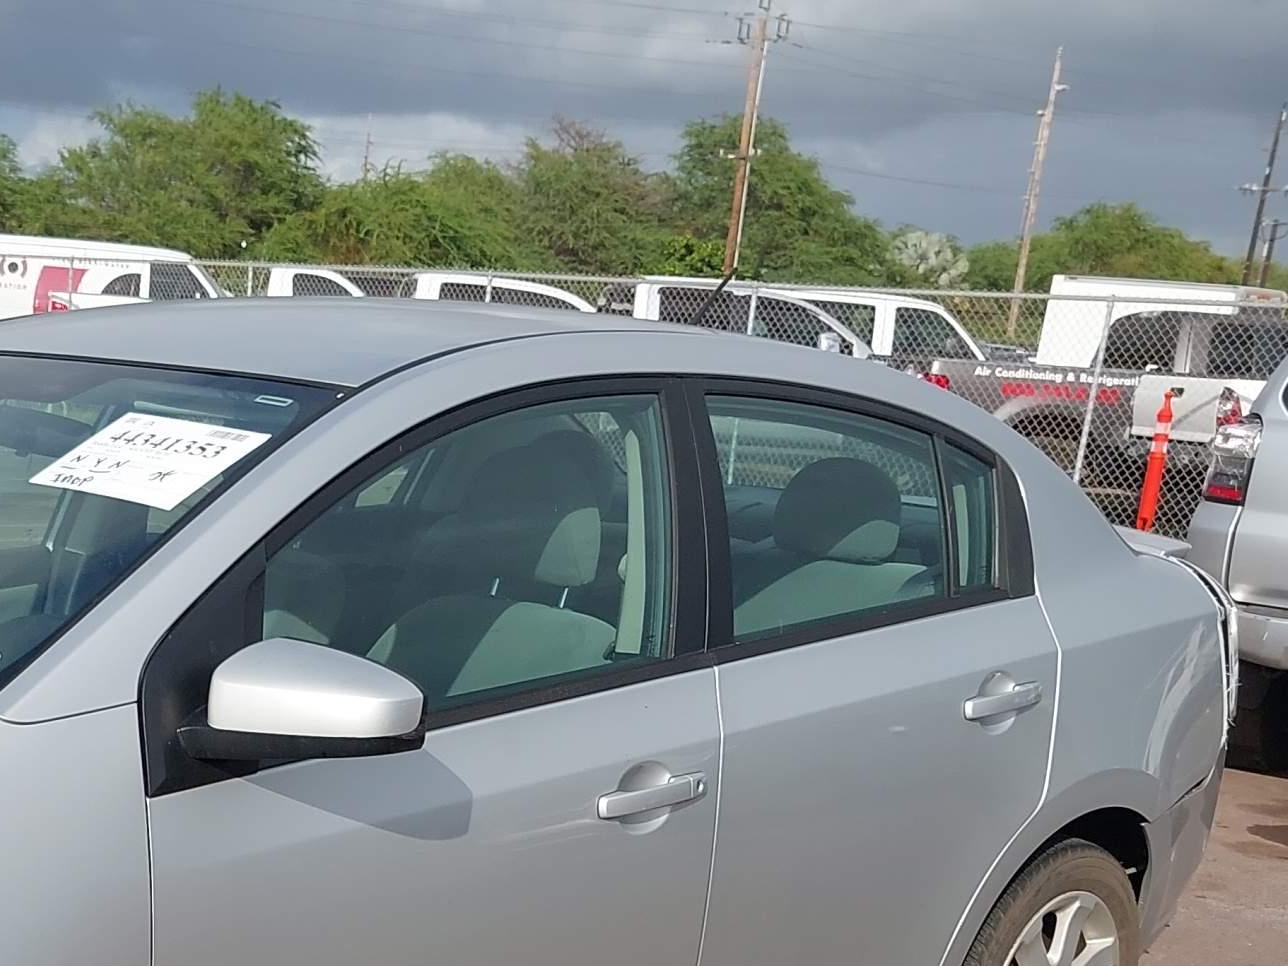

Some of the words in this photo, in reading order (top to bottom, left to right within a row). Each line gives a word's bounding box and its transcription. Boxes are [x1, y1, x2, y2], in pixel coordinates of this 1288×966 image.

[974, 366, 992, 376] Air
[994, 367, 1064, 383] Conditioning
[1066, 372, 1076, 382] &
[1080, 373, 1140, 387] Rerigerati
[110, 430, 228, 460] 44341353
